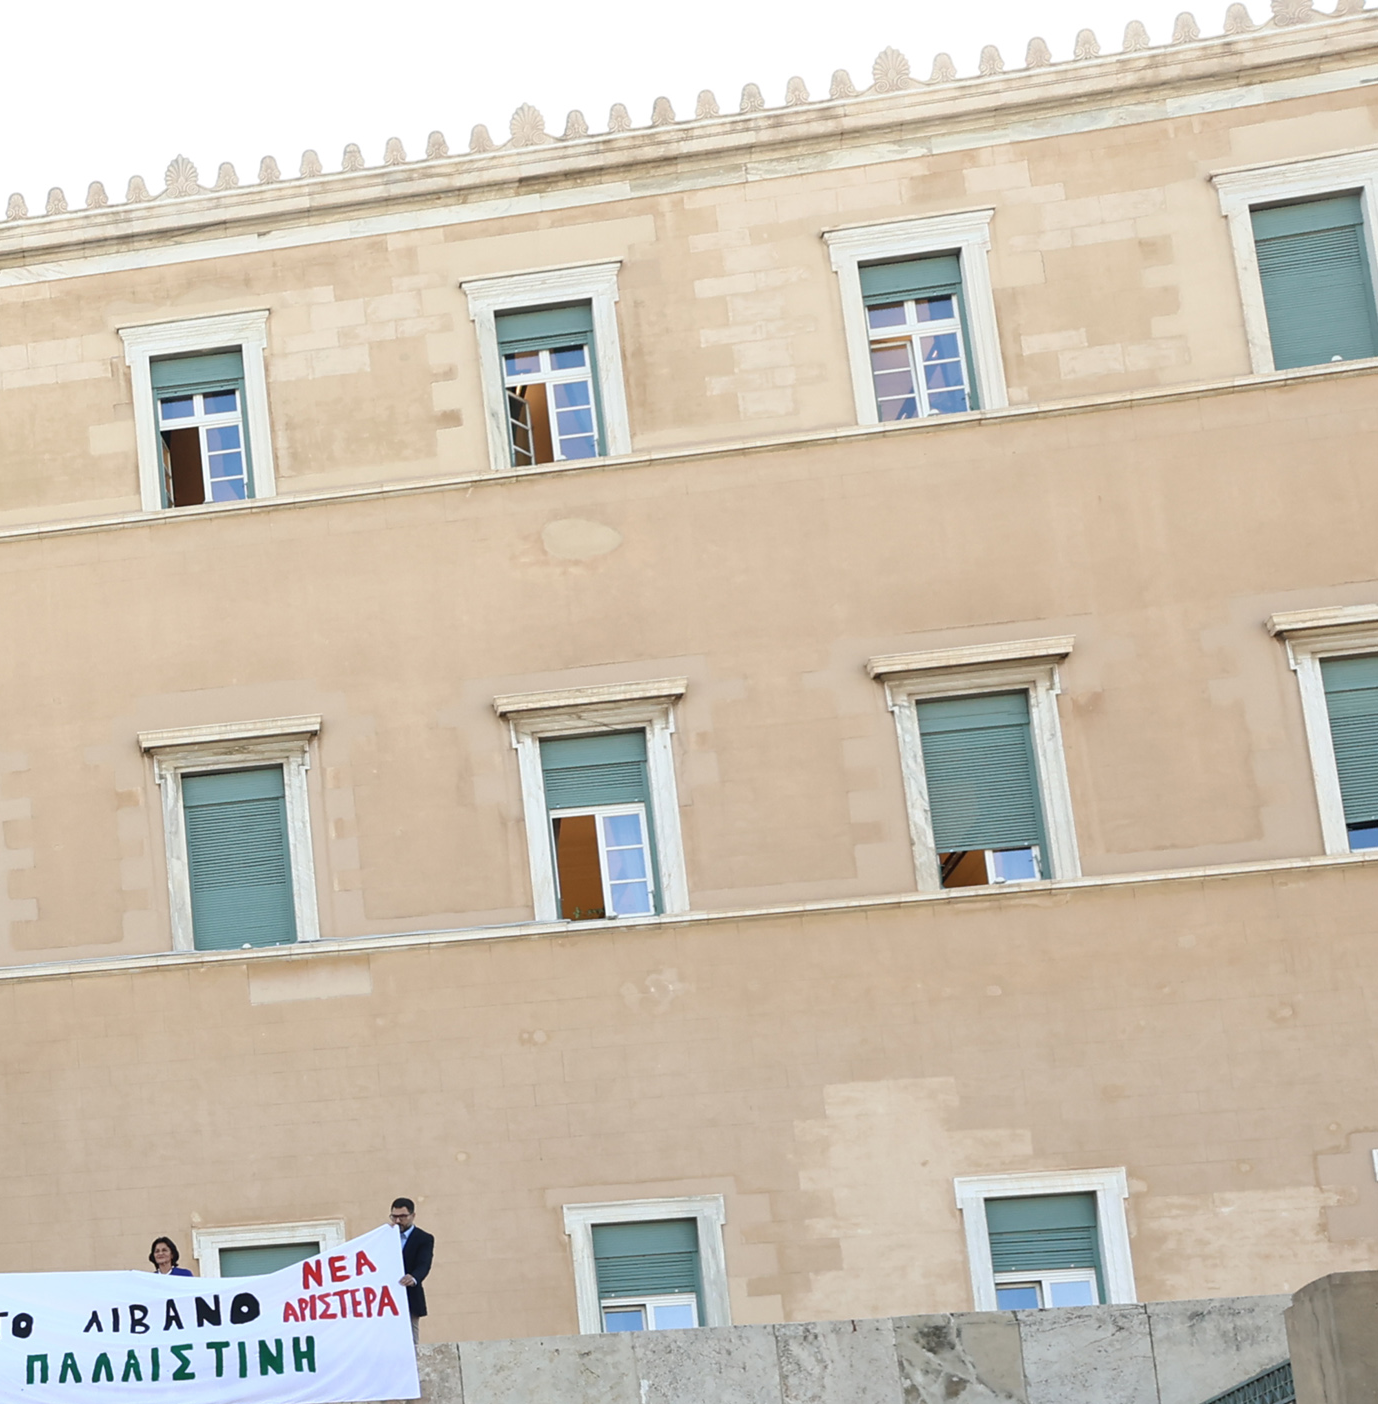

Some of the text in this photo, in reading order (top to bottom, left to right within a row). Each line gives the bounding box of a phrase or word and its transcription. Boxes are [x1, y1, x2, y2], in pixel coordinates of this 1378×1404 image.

[302, 1250, 377, 1289] ΝΕΑ
[83, 1292, 261, 1334] ΛΙΒΑΝΟ
[283, 1286, 399, 1323] ΑΡΙΣΤΕΡΑ
[26, 1336, 316, 1385] ΠΑΛΑΙΣΤΙΝΗ
